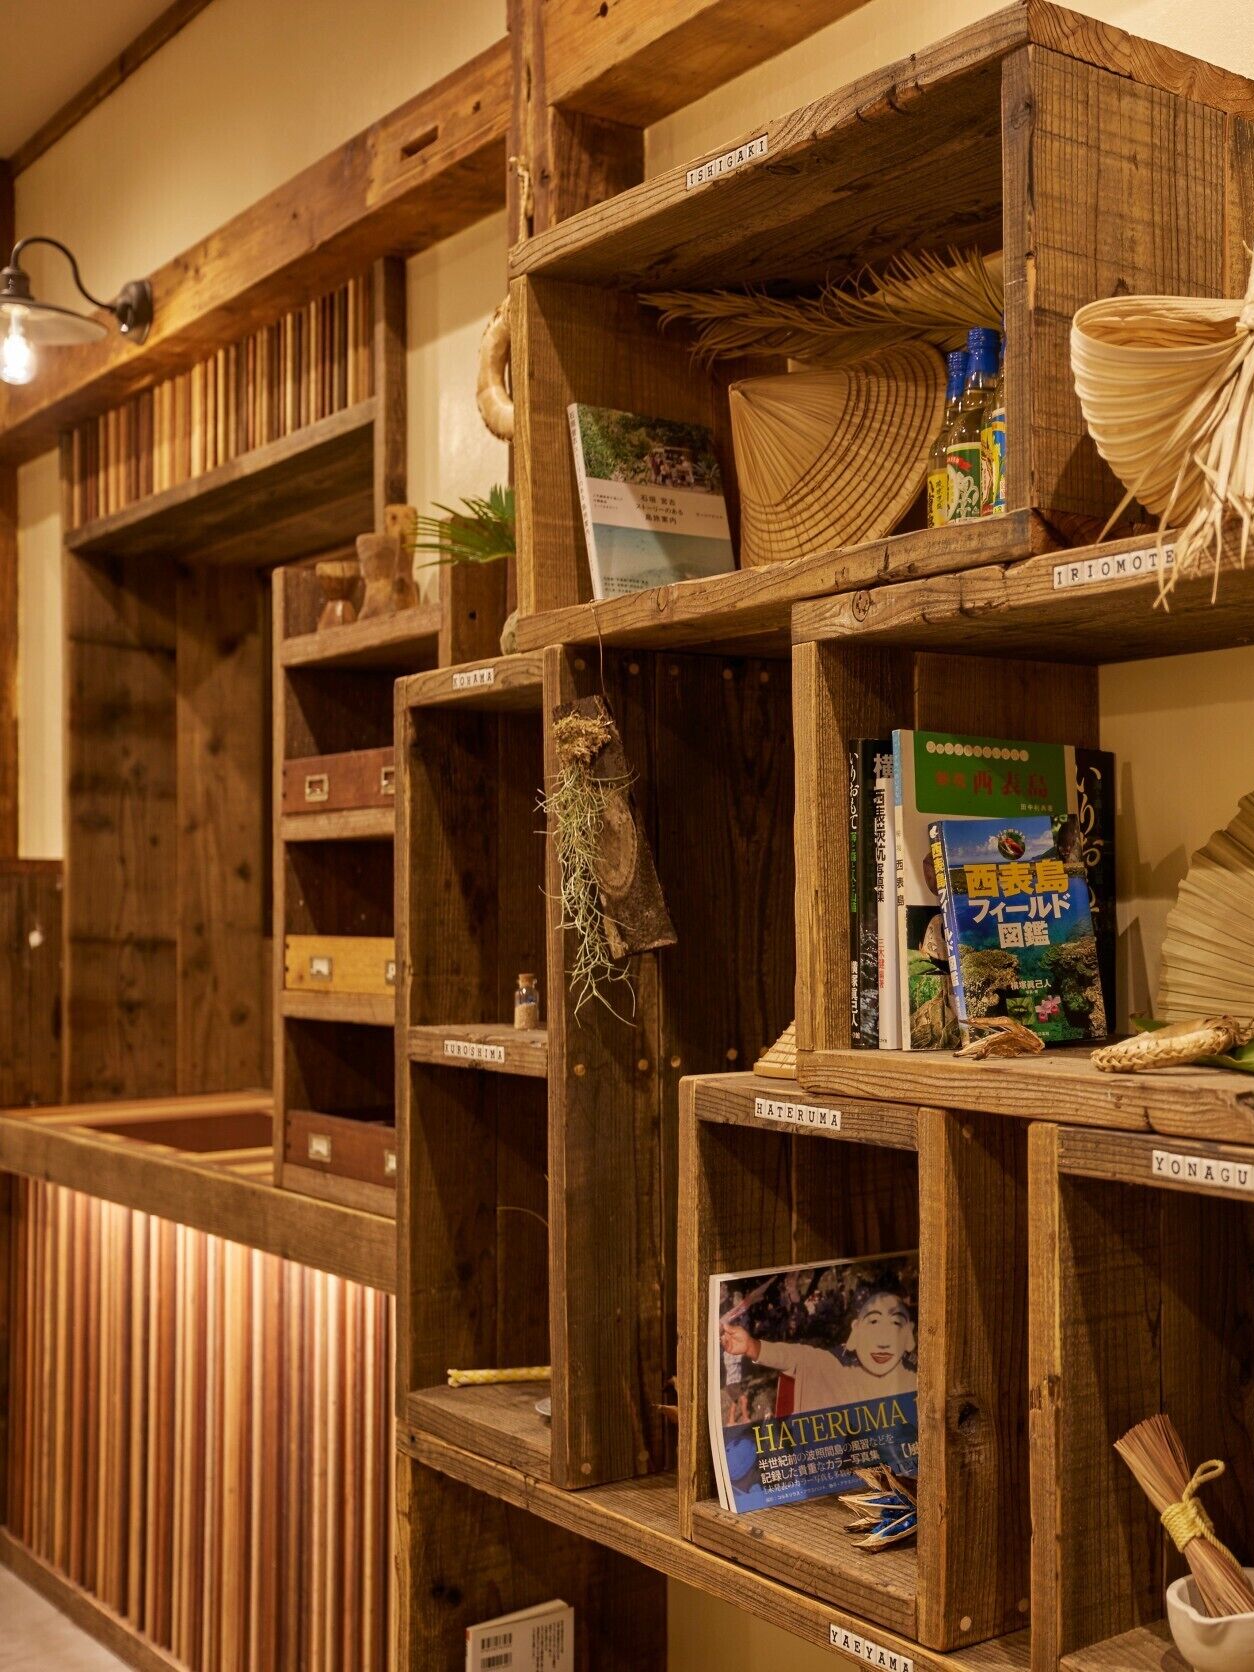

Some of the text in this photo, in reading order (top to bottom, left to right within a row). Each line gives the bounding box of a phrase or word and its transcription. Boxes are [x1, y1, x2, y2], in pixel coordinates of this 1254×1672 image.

[689, 140, 764, 184] ISHIGAKI
[1056, 549, 1175, 586] IRIOMOTE
[453, 671, 492, 687] KOHAMA
[963, 857, 1069, 899] 西表島
[968, 892, 1071, 923] フィールド
[997, 920, 1051, 949] 図鑑
[444, 1044, 503, 1060] KUROSHIMA
[756, 1103, 838, 1127] HATERUMA
[752, 1399, 909, 1454] HATERUMA
[831, 1629, 910, 1672] YAEYAMA
